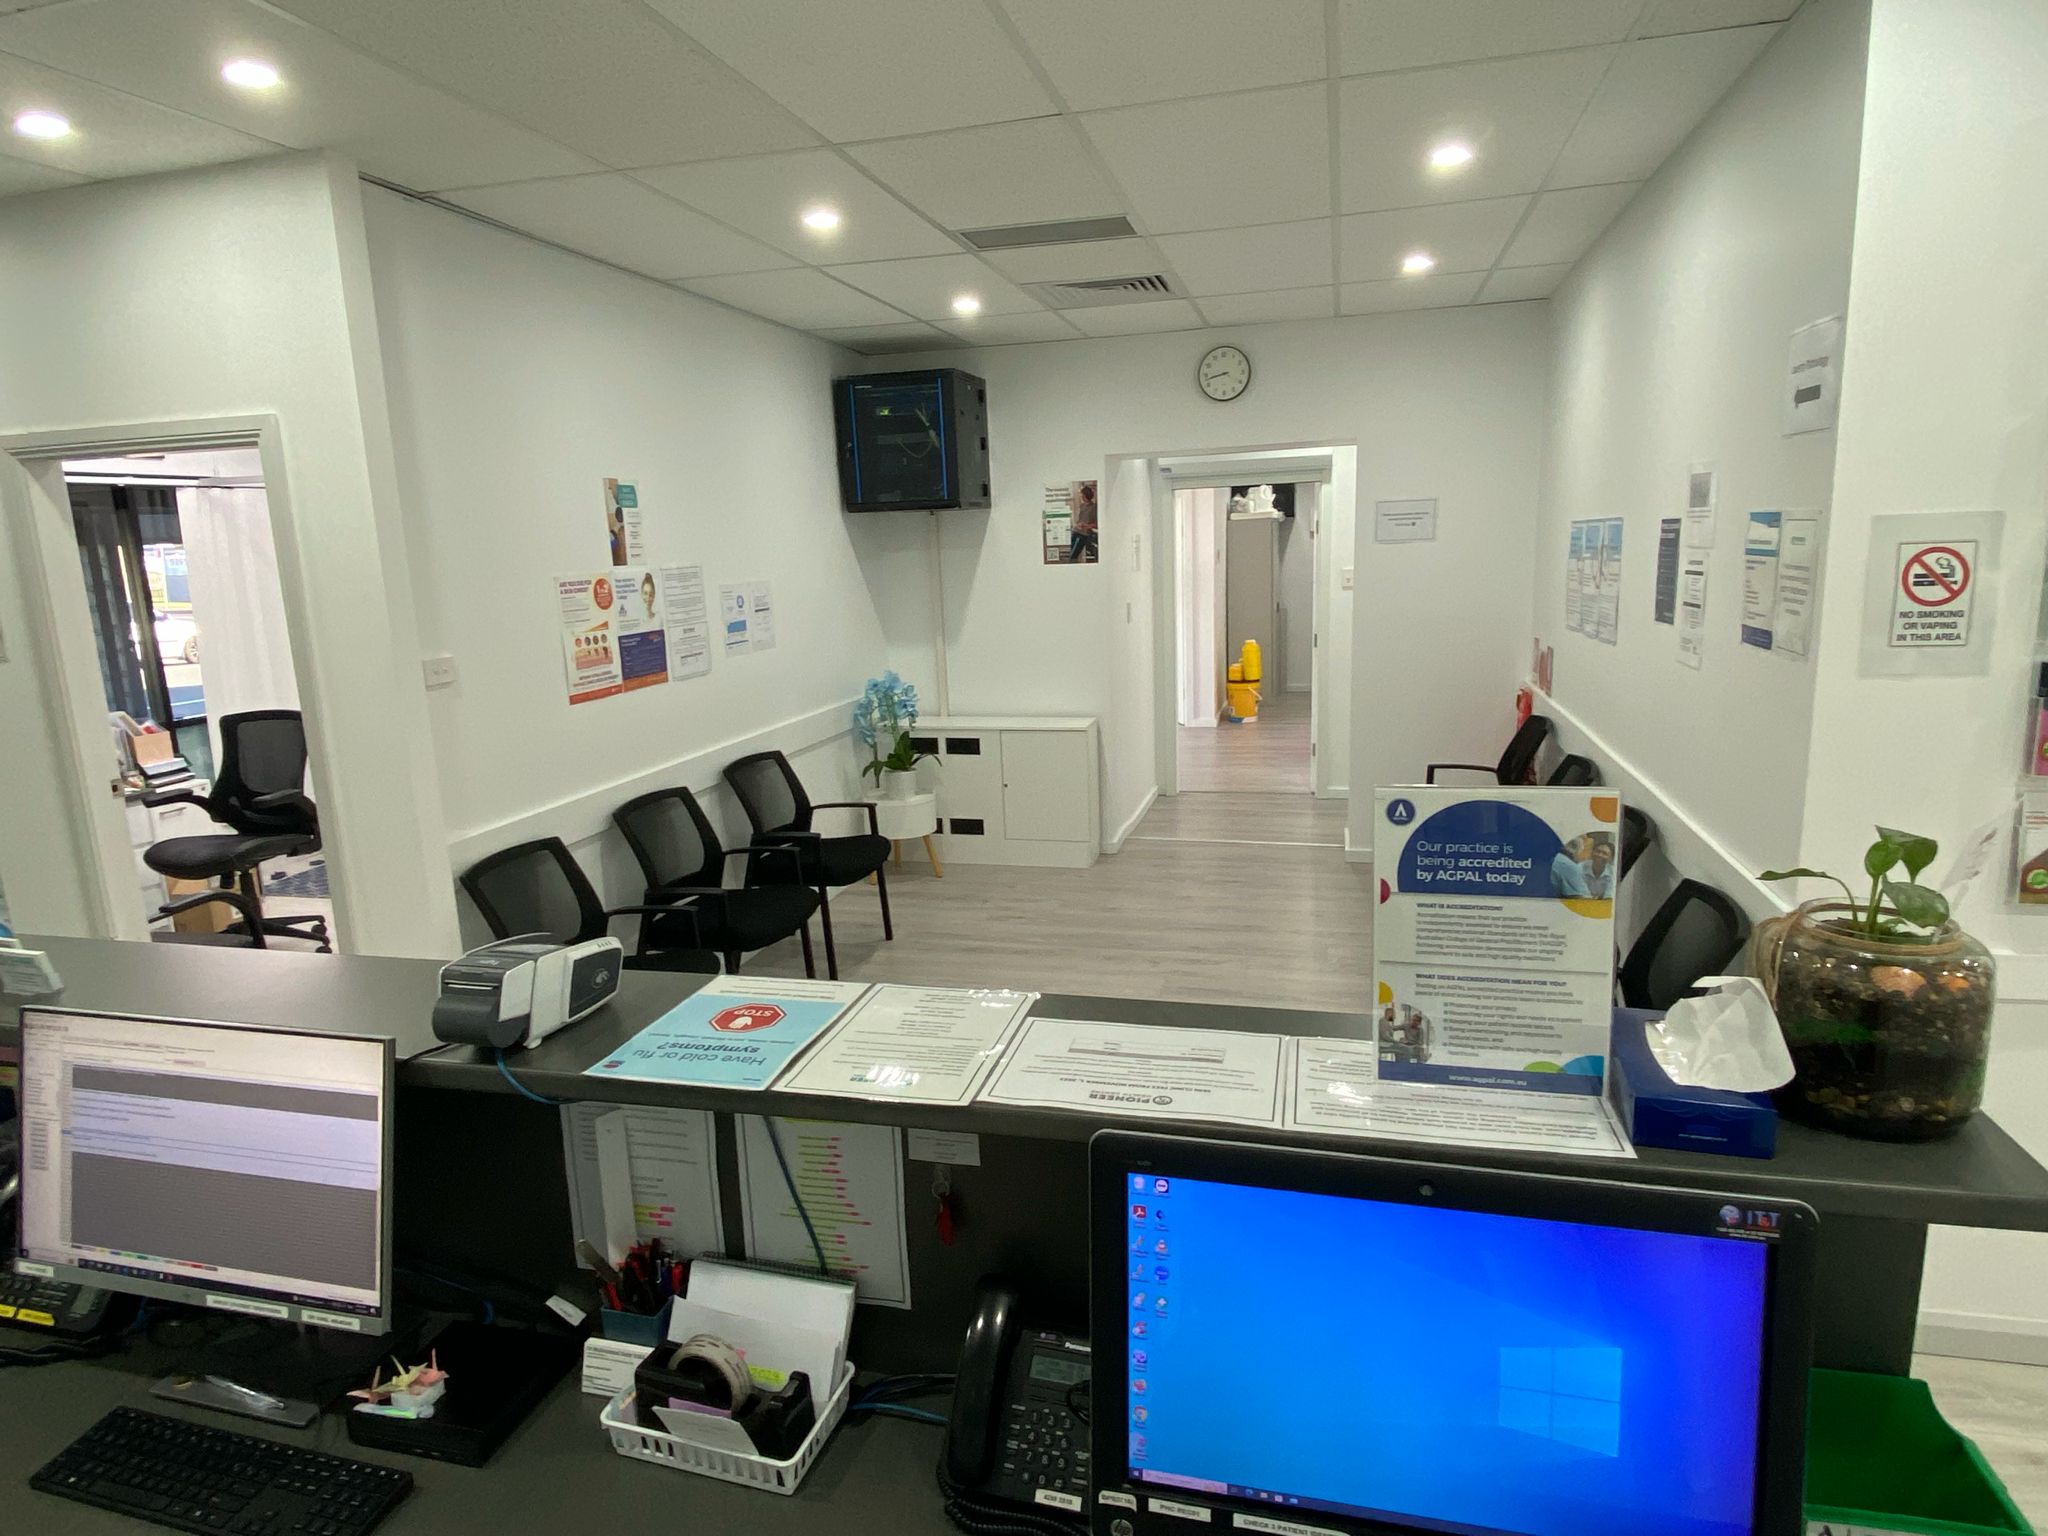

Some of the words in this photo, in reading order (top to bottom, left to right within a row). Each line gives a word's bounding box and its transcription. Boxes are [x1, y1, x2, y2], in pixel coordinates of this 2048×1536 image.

[1899, 611, 1914, 619] NO
[1917, 610, 1964, 618] SMOKING
[1903, 622, 1917, 630] OR
[1920, 621, 1958, 630] VAPING
[1896, 633, 1907, 641] IN
[1910, 633, 1932, 641] THIS
[1934, 633, 1961, 641] AREA
[1416, 841, 1442, 852] Our
[1445, 842, 1499, 854] practice
[1503, 843, 1514, 854] is
[1417, 855, 1455, 868] being
[1458, 857, 1532, 869] accredited
[1416, 869, 1434, 882] by
[1436, 870, 1483, 881] AGPAL
[1486, 872, 1526, 886] today
[733, 1008, 774, 1017] STOP
[656, 1041, 761, 1053] symptoms?
[632, 1050, 655, 1060] flu
[679, 1052, 718, 1062] cold
[721, 1056, 767, 1066] Have
[1089, 1093, 1151, 1104] PIONEER
